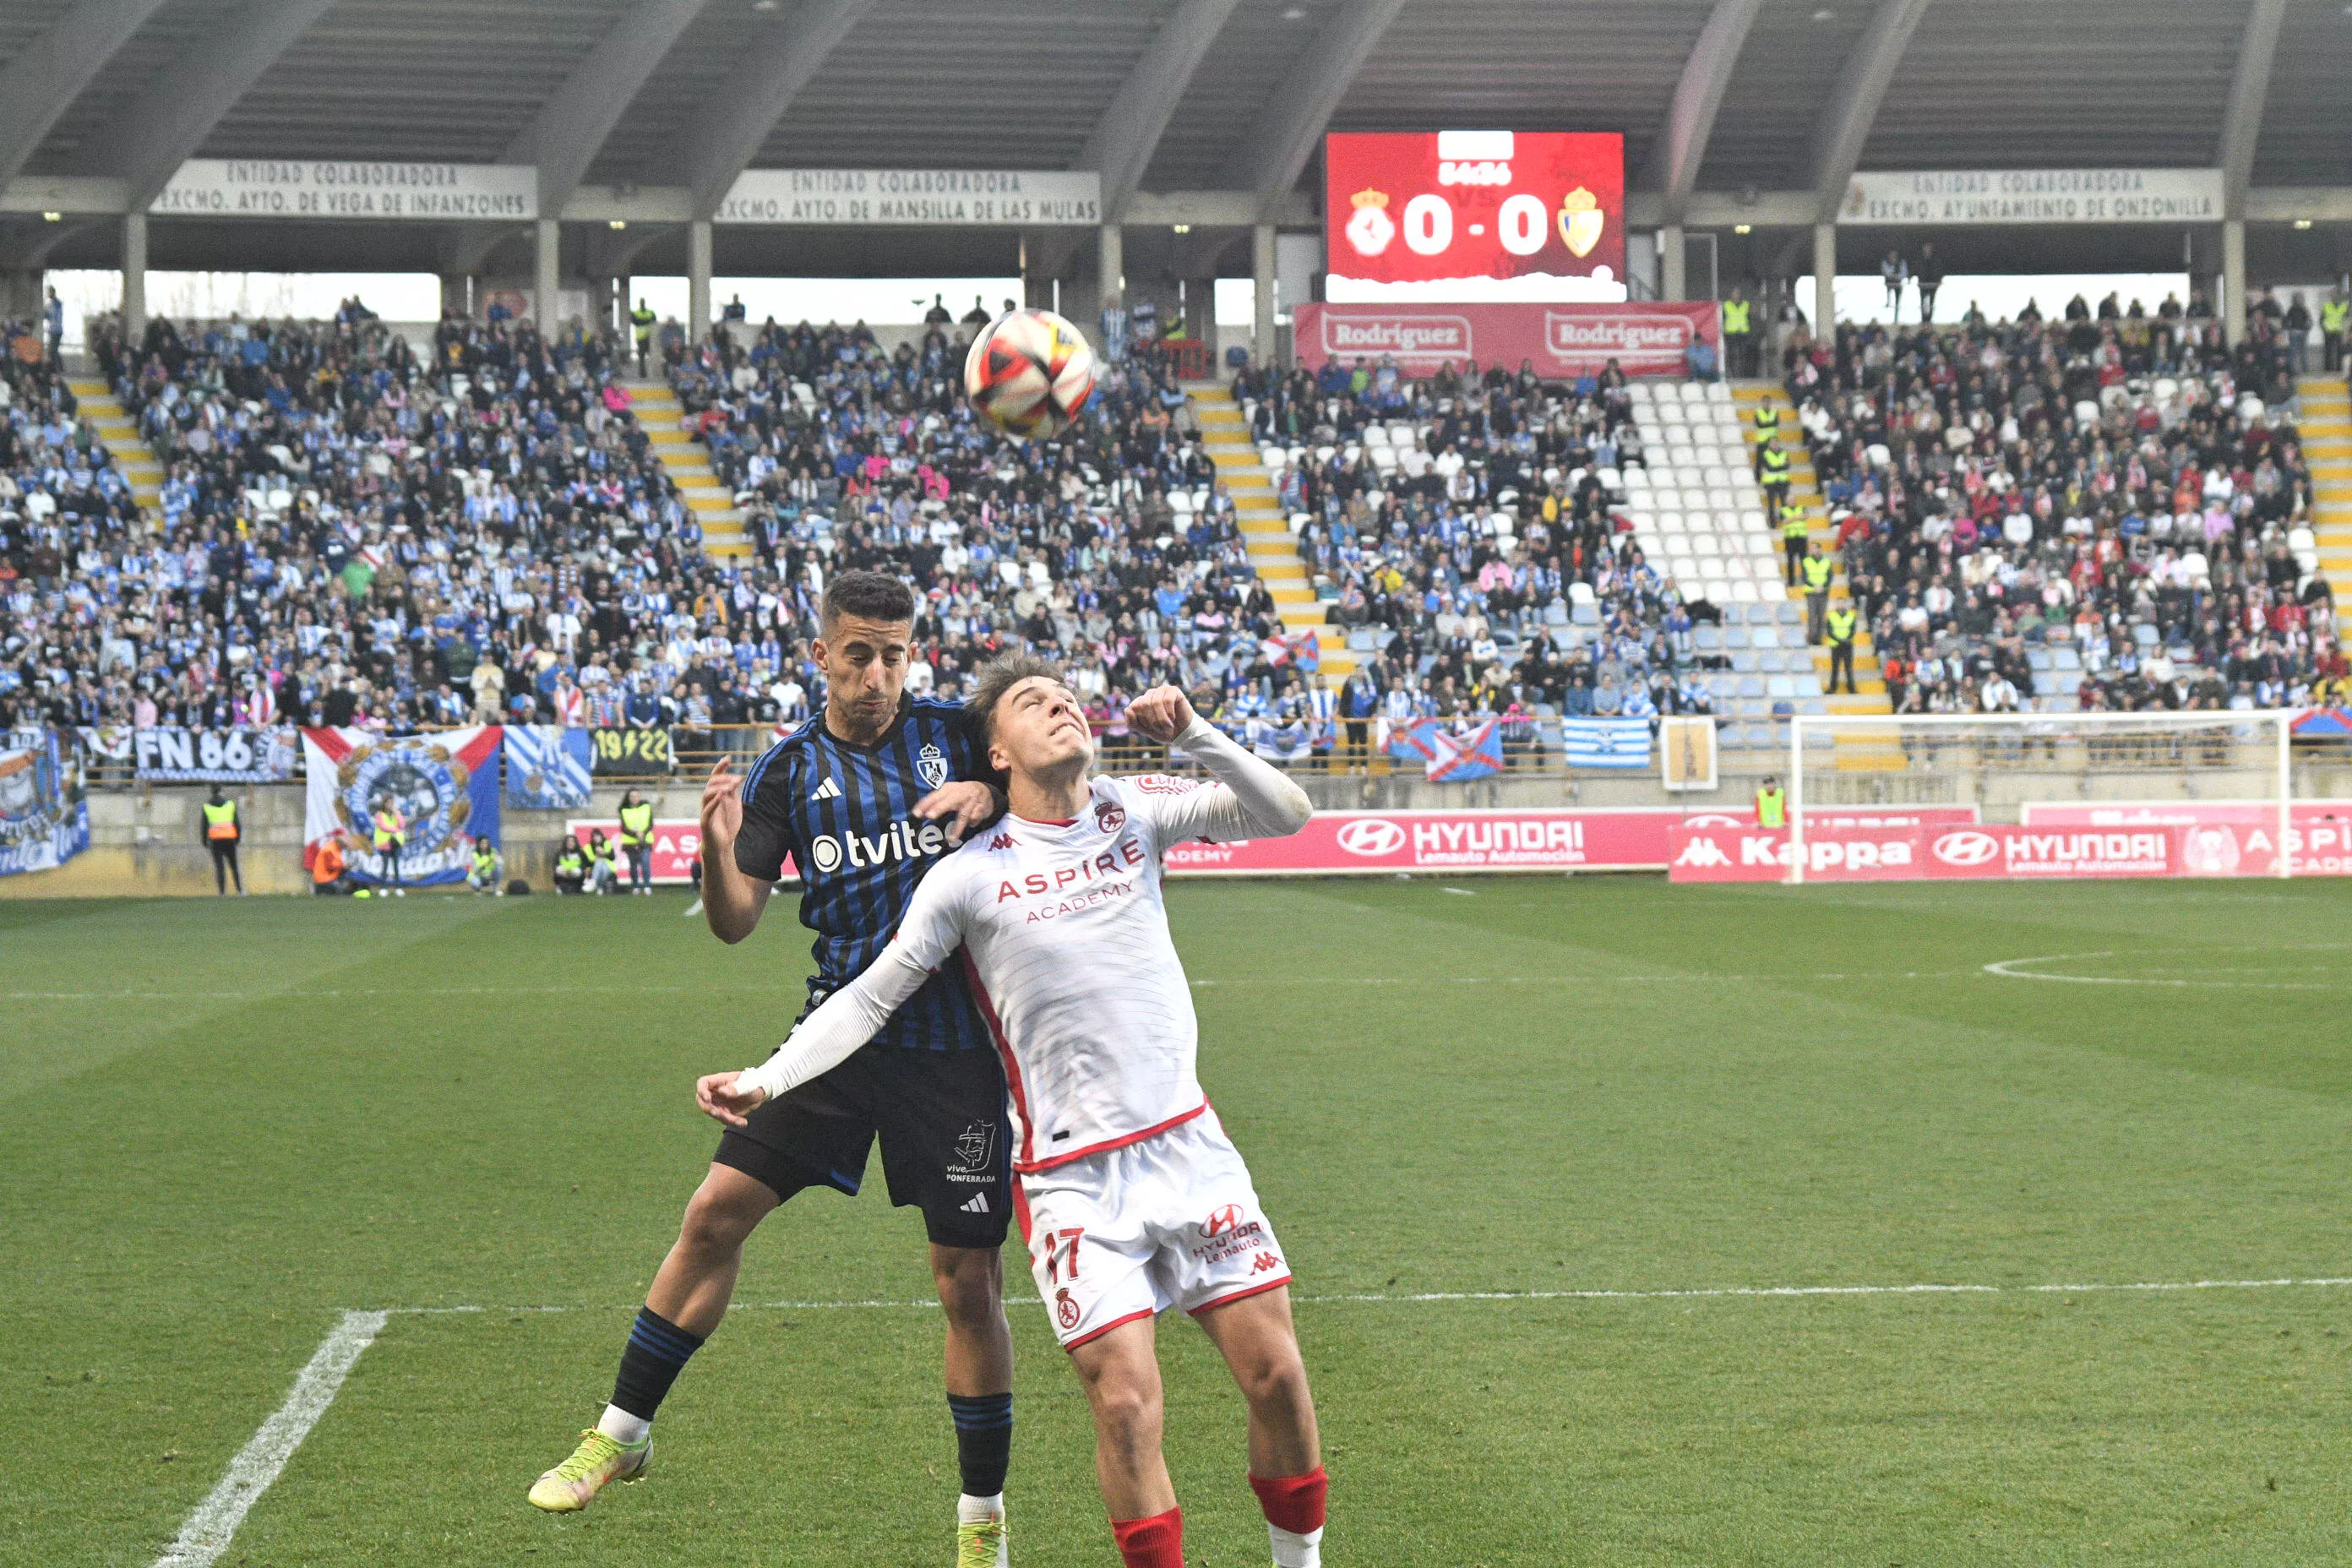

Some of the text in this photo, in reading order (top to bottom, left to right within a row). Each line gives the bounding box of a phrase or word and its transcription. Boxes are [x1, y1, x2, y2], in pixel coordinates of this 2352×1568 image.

[227, 164, 457, 186] ENTIDAD COLABORADORA
[792, 172, 1021, 193] ENTIDAD COLABORADORA
[1914, 172, 2144, 193] ENTIDAD COLABORADORA
[299, 192, 320, 211] DE
[328, 193, 374, 212] VEGA
[381, 193, 402, 213] DE
[410, 193, 524, 215] INFANZONES
[849, 200, 868, 219] DE
[879, 200, 965, 220] MANSILLA
[974, 200, 994, 220] DE
[1001, 200, 1031, 220] LAS
[1038, 200, 1096, 220] MULAS
[1944, 199, 2077, 218] AYUNTAMIENTO
[2087, 198, 2106, 216] DE
[2114, 197, 2212, 217] ONZONILLA
[1403, 194, 1453, 255] 0
[1499, 194, 1548, 255] 0
[135, 731, 194, 769] FN
[1413, 820, 1584, 850] HYUNDAI
[2005, 833, 2167, 859] HYUNDAI
[1741, 836, 1912, 871] Kappa
[998, 839, 1146, 903] ASPIRE
[1026, 880, 1134, 924] ACADEMY
[946, 1164, 967, 1173] vive
[946, 1174, 996, 1183] PONFERRADA
[1045, 1227, 1085, 1285] 17
[1206, 1238, 1260, 1264] Lemauto
